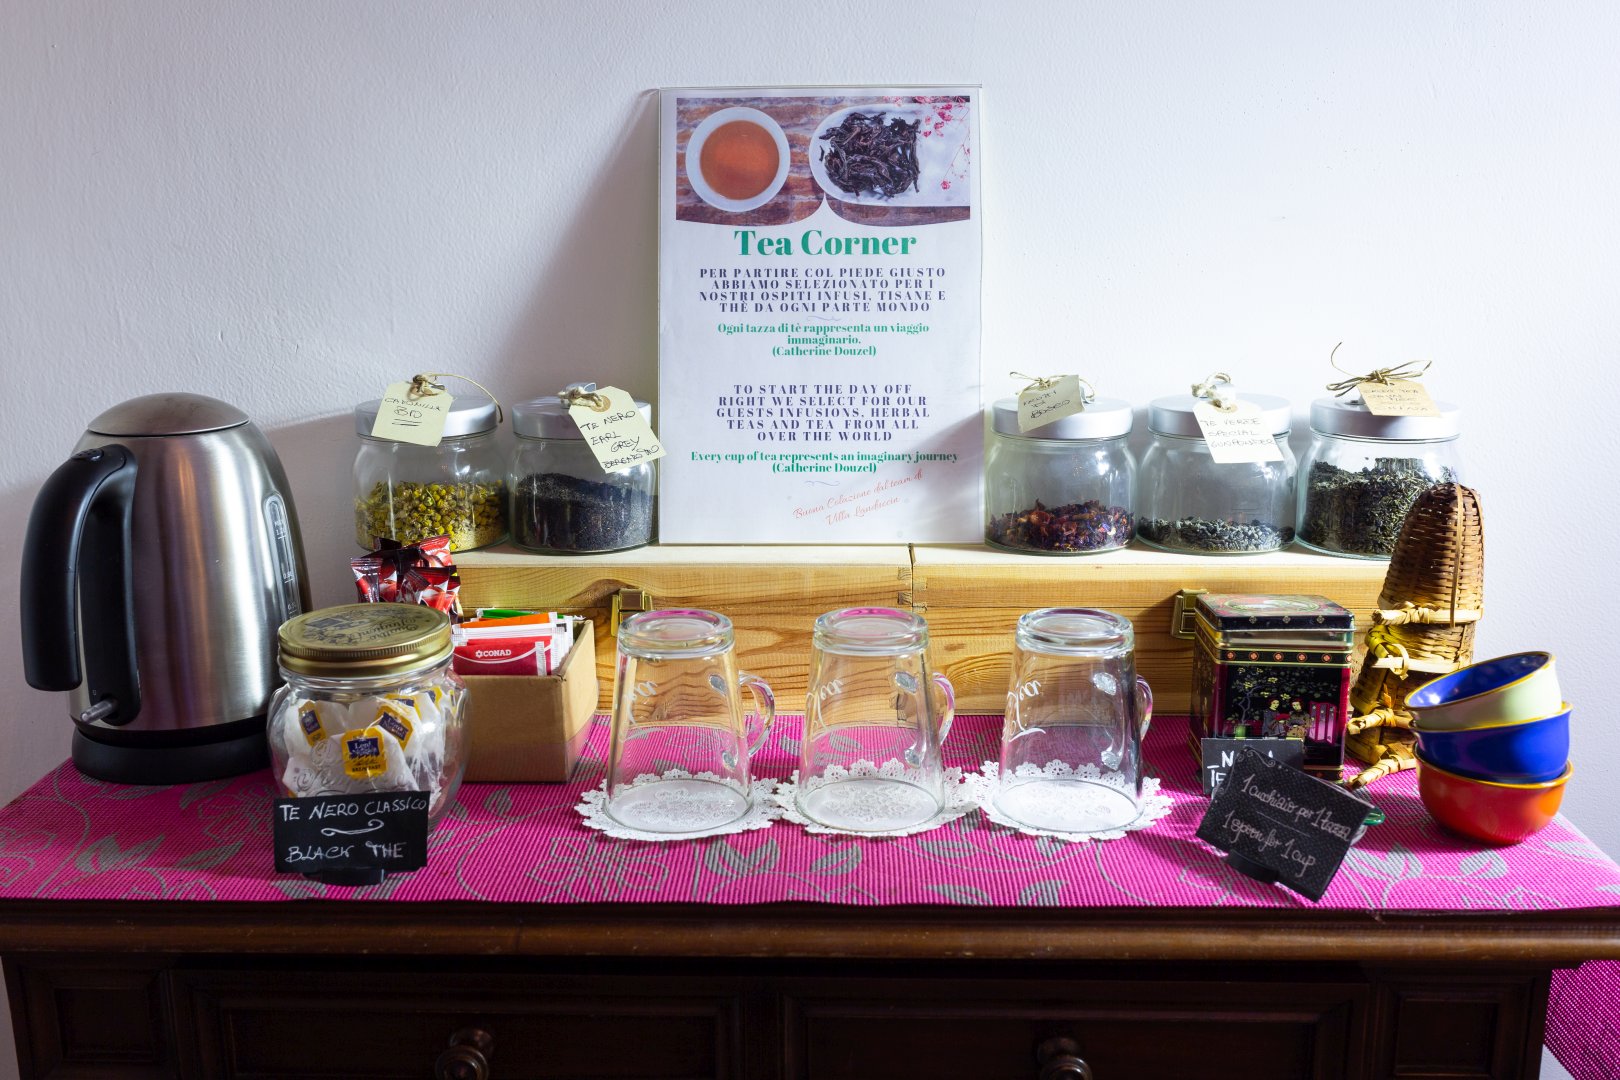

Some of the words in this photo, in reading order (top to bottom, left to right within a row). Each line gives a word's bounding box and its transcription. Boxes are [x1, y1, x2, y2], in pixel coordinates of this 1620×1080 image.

[734, 230, 793, 255] Tea
[801, 230, 916, 255] Corner
[700, 268, 727, 278] PER
[734, 268, 798, 278] PARTIRE
[805, 268, 833, 278] COL
[840, 268, 883, 278] PIEDE
[890, 268, 945, 278] GIUSTO
[712, 279, 779, 289] ABBIAMO
[786, 279, 888, 289] SELEZIONATO
[896, 279, 922, 289] PER
[930, 279, 932, 289] I
[700, 291, 754, 301] NOSTRI
[761, 291, 810, 301] OSPITI
[878, 291, 931, 301] TISANE
[939, 291, 945, 301] E
[720, 299, 747, 312] THÈ
[755, 302, 773, 312] DA
[780, 302, 815, 312] OGNI
[823, 302, 870, 312] PARTE
[877, 302, 931, 312] MONDO
[718, 323, 743, 335] Ogni
[746, 324, 775, 333] tazza
[778, 323, 790, 333] di
[791, 323, 801, 333] tè
[804, 325, 871, 336] rappresenta
[890, 324, 929, 335] viaggio
[788, 335, 861, 346] immaginario.
[772, 346, 831, 357] (Catherine
[835, 346, 876, 357] Douzel)
[734, 384, 752, 394] TO
[760, 384, 807, 394] START
[814, 384, 842, 394] THE
[850, 384, 877, 394] DAY
[885, 384, 911, 394] OFF
[719, 396, 765, 406] RIGHT
[772, 396, 793, 406] WE
[800, 396, 855, 406] SELECT
[862, 396, 890, 406] FOR
[897, 396, 926, 406] OUR
[603, 410, 636, 424] NERO
[717, 408, 773, 418] GUESTS
[872, 408, 929, 418] HERBAL
[727, 420, 763, 429] TEAS
[771, 420, 799, 429] AND
[806, 420, 833, 429] TEA
[845, 420, 886, 429] FROM
[893, 420, 918, 429] ALL
[591, 432, 621, 445] EARL
[758, 432, 796, 441] OVER
[803, 432, 831, 441] THE
[839, 432, 891, 441] WORLD
[611, 436, 640, 452] GREY
[691, 452, 723, 463] Every
[725, 454, 744, 463] cup
[747, 451, 759, 461] of
[760, 452, 777, 461] tea
[780, 452, 838, 463] represents
[857, 452, 913, 463] imaginary
[914, 452, 958, 463] journey
[772, 462, 832, 473] (Catherine
[835, 462, 876, 473] Douzel)
[827, 489, 871, 509] Colazione
[483, 649, 512, 657] CONAD
[279, 804, 300, 821] TE
[309, 802, 358, 820] NERO
[365, 796, 427, 815] CLASSICO
[285, 845, 354, 863] BLACK
[365, 841, 407, 858] THE
[1230, 818, 1264, 843] spoon
[1259, 829, 1282, 851] for
[1291, 853, 1316, 878] cup
